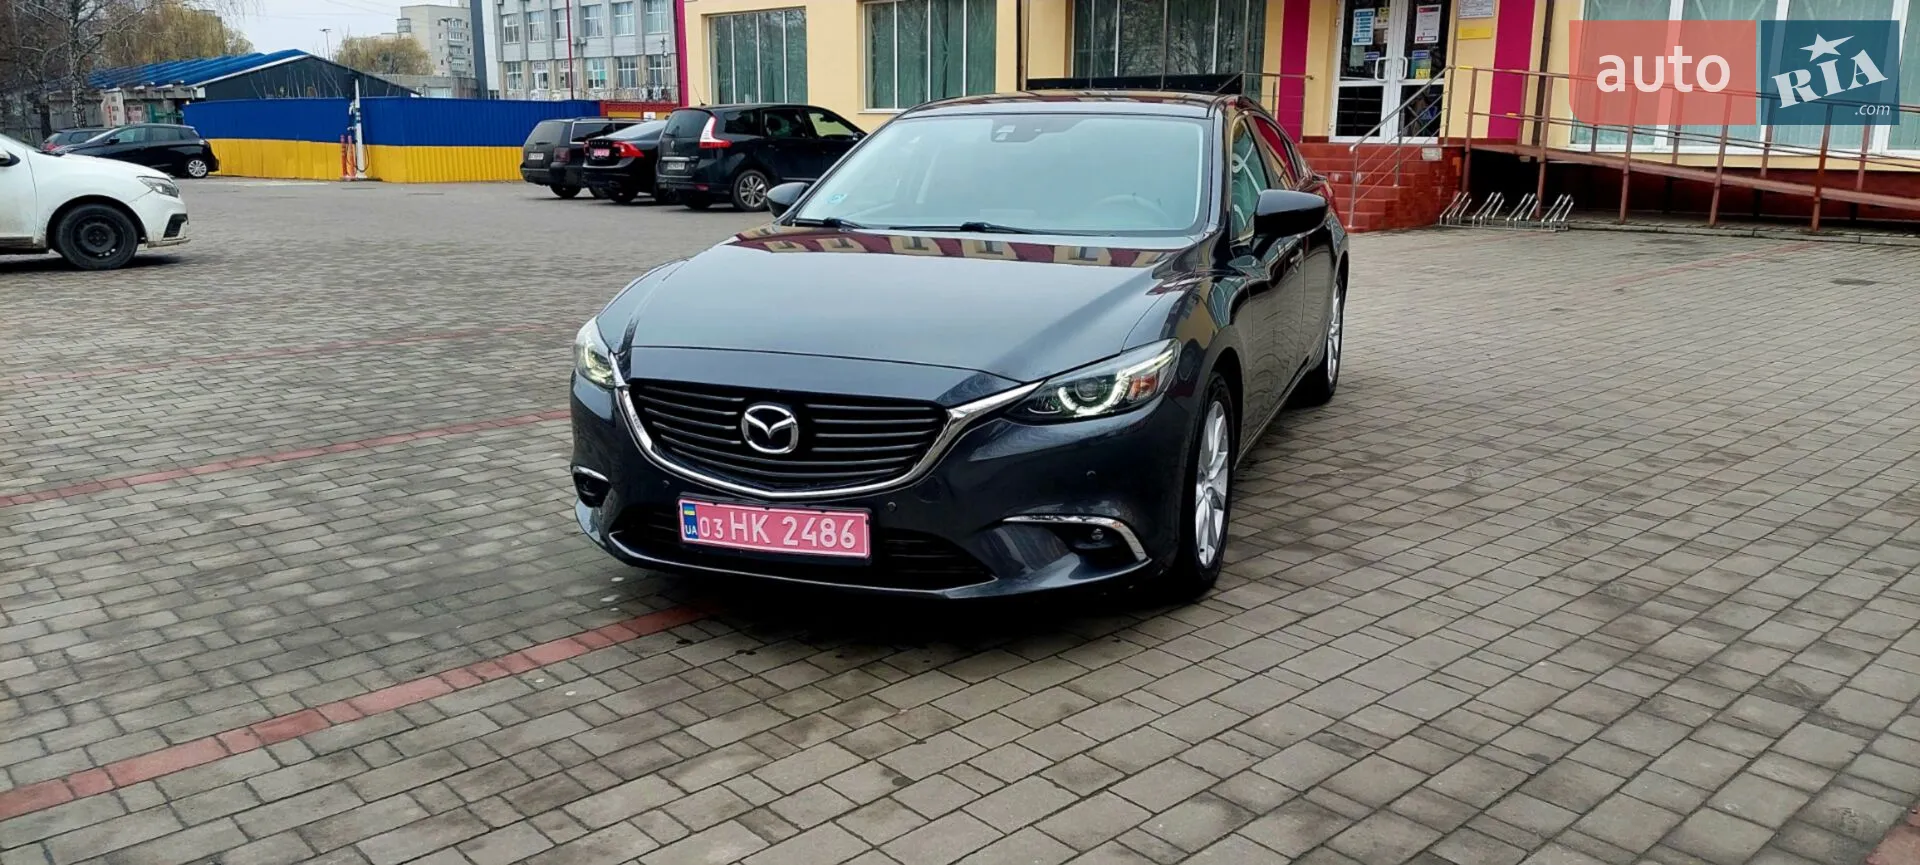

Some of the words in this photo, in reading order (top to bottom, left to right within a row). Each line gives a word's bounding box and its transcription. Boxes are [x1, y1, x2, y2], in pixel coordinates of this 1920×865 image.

[685, 524, 698, 536] UA
[699, 516, 725, 539] 03
[729, 511, 771, 544] HK
[781, 516, 856, 549] 2486
